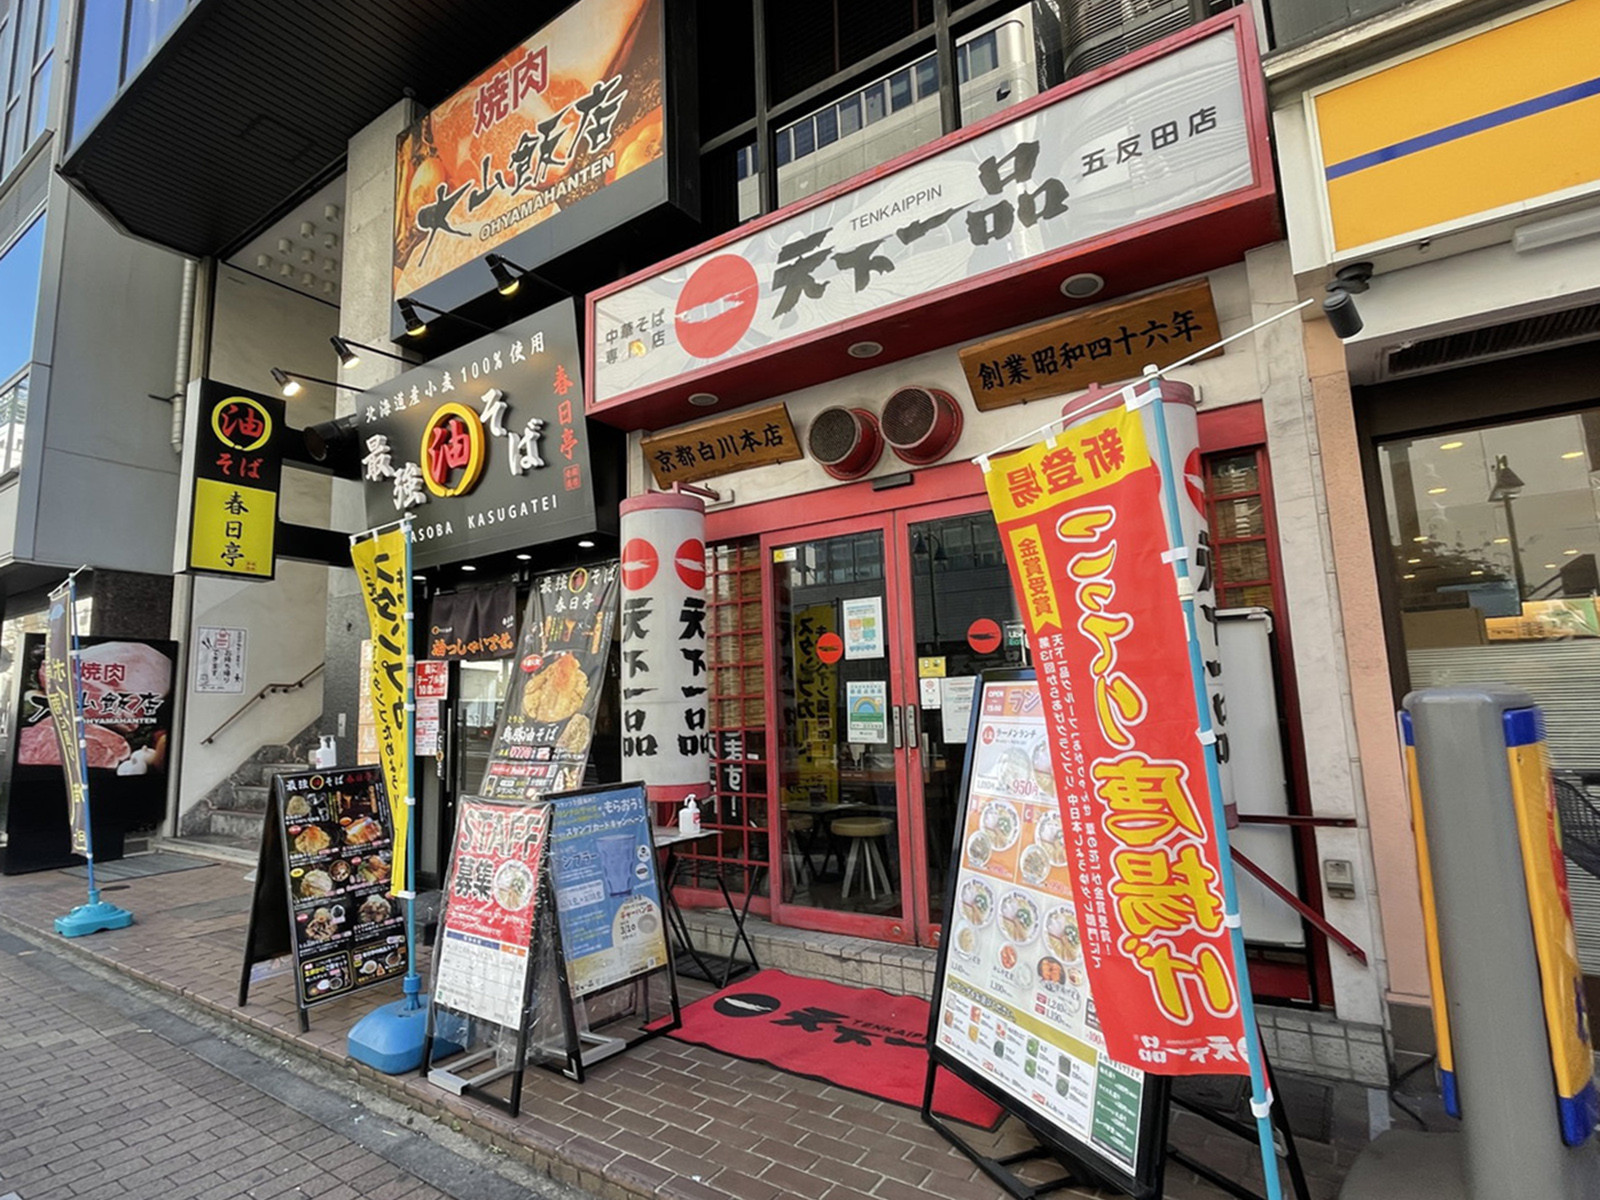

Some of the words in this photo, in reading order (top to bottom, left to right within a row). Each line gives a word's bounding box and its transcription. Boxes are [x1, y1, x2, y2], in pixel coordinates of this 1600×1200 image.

[473, 46, 547, 137] 焼肉
[1081, 106, 1218, 177] 五反田店
[417, 74, 628, 267] 大山飯店
[479, 152, 616, 241] OHYAMAHANTEN
[850, 184, 943, 232] TENKAIPPIN
[772, 141, 1069, 319] 天下一品
[606, 308, 664, 344] 中華そば
[606, 330, 665, 364] 専店
[977, 309, 1203, 391] 創業昭和四十六年
[222, 404, 264, 439] 油
[553, 365, 578, 461] 春日亭
[216, 453, 263, 479] そば
[655, 423, 785, 473] 京都白川本店
[220, 491, 249, 567] 春日亭
[468, 494, 558, 529] KASUGATEI
[73, 661, 125, 681] 焼肉
[623, 597, 658, 757] 天下一品
[678, 597, 709, 757] 天下一品
[84, 717, 157, 725] HYAMAHANTEN
[460, 809, 542, 858] STAFF
[454, 856, 494, 899] 募集
